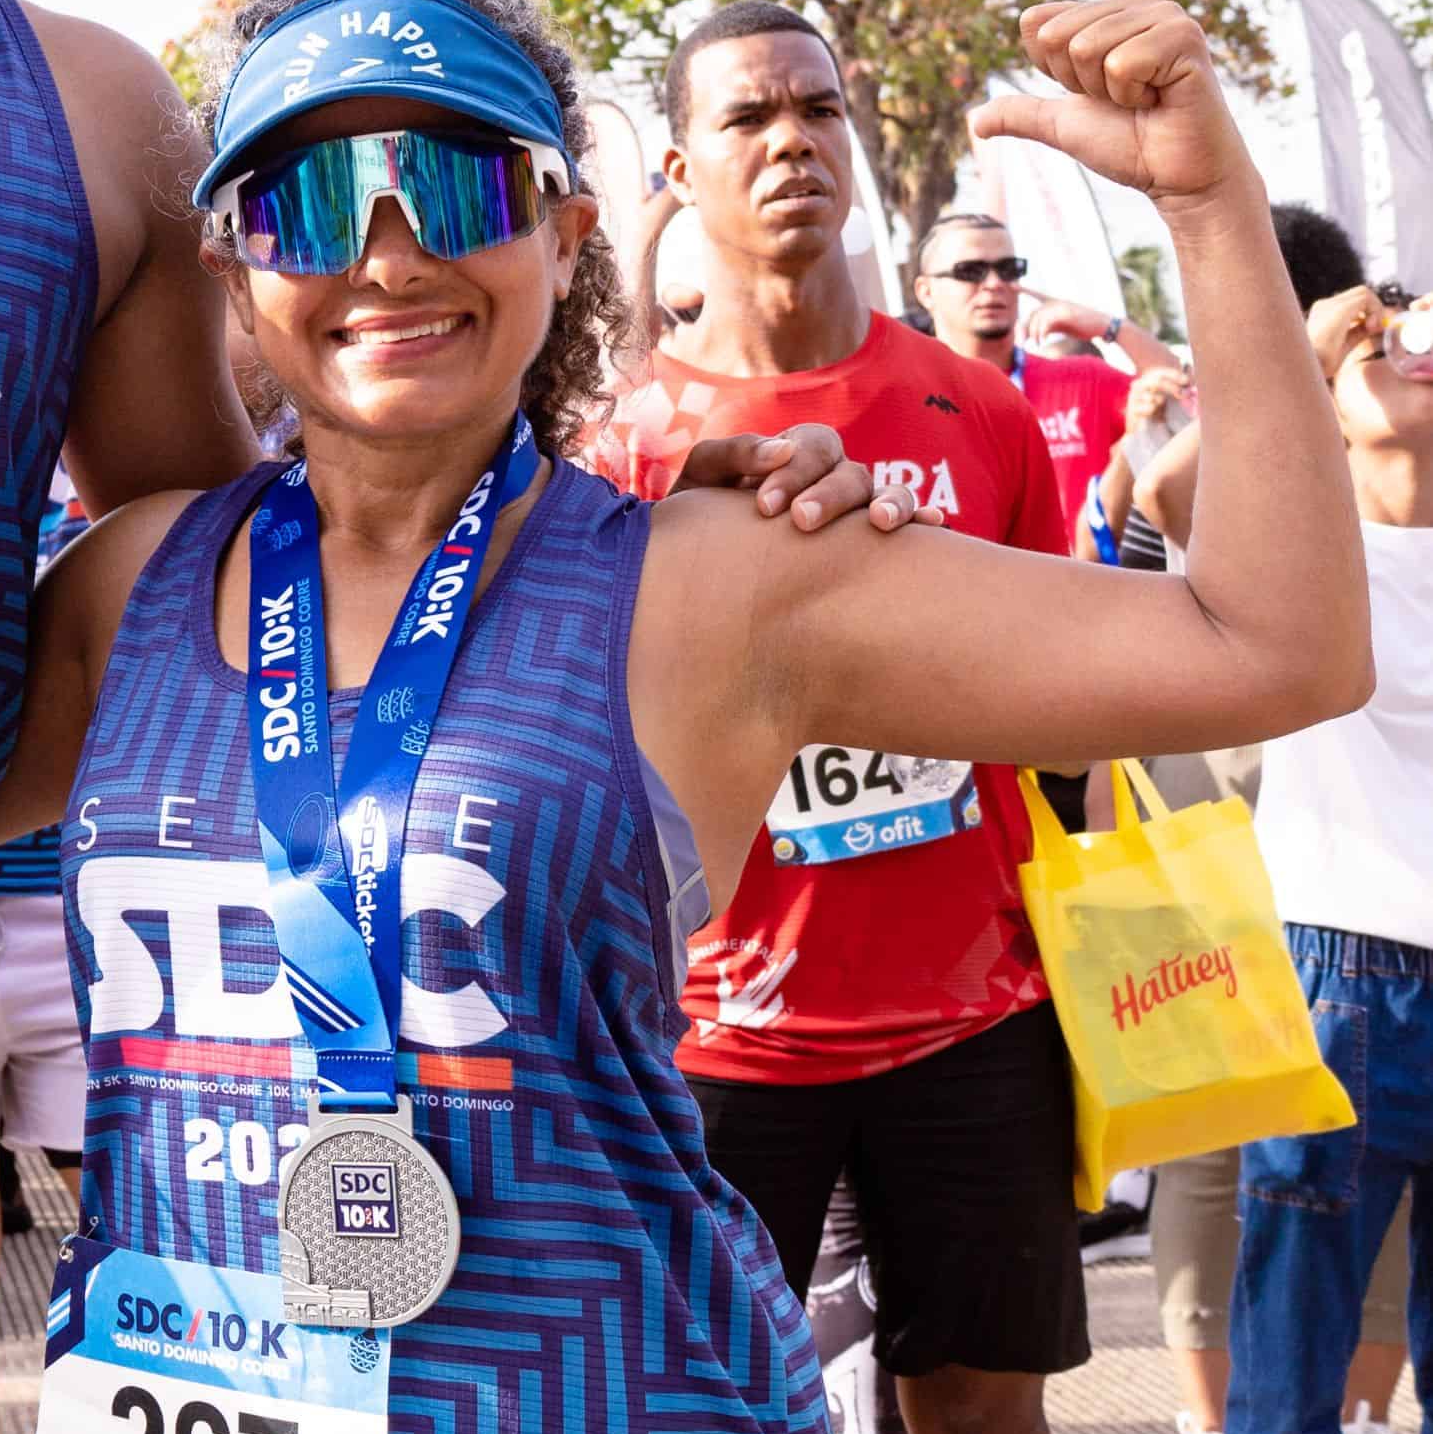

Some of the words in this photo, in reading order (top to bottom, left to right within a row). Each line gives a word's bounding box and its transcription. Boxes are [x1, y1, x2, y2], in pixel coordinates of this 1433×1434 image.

[282, 31, 330, 106] RUN
[340, 10, 445, 78] HAPPY
[297, 577, 311, 623] CORRE
[394, 602, 421, 647] CORRE
[299, 626, 315, 699] DOMINGO
[301, 700, 318, 754] SANTO
[880, 816, 925, 843] ofit
[1111, 946, 1238, 1031] Hatuey
[104, 1074, 122, 1087] 5K
[129, 1074, 157, 1088] SANTO
[160, 1077, 218, 1094] DOMINGO
[221, 1082, 263, 1096] CORRE
[268, 1085, 290, 1098] 10K
[411, 1094, 439, 1107] NTO
[443, 1096, 515, 1112] DOMINGO
[340, 1172, 387, 1194] SDC
[116, 1334, 161, 1356] SANTO
